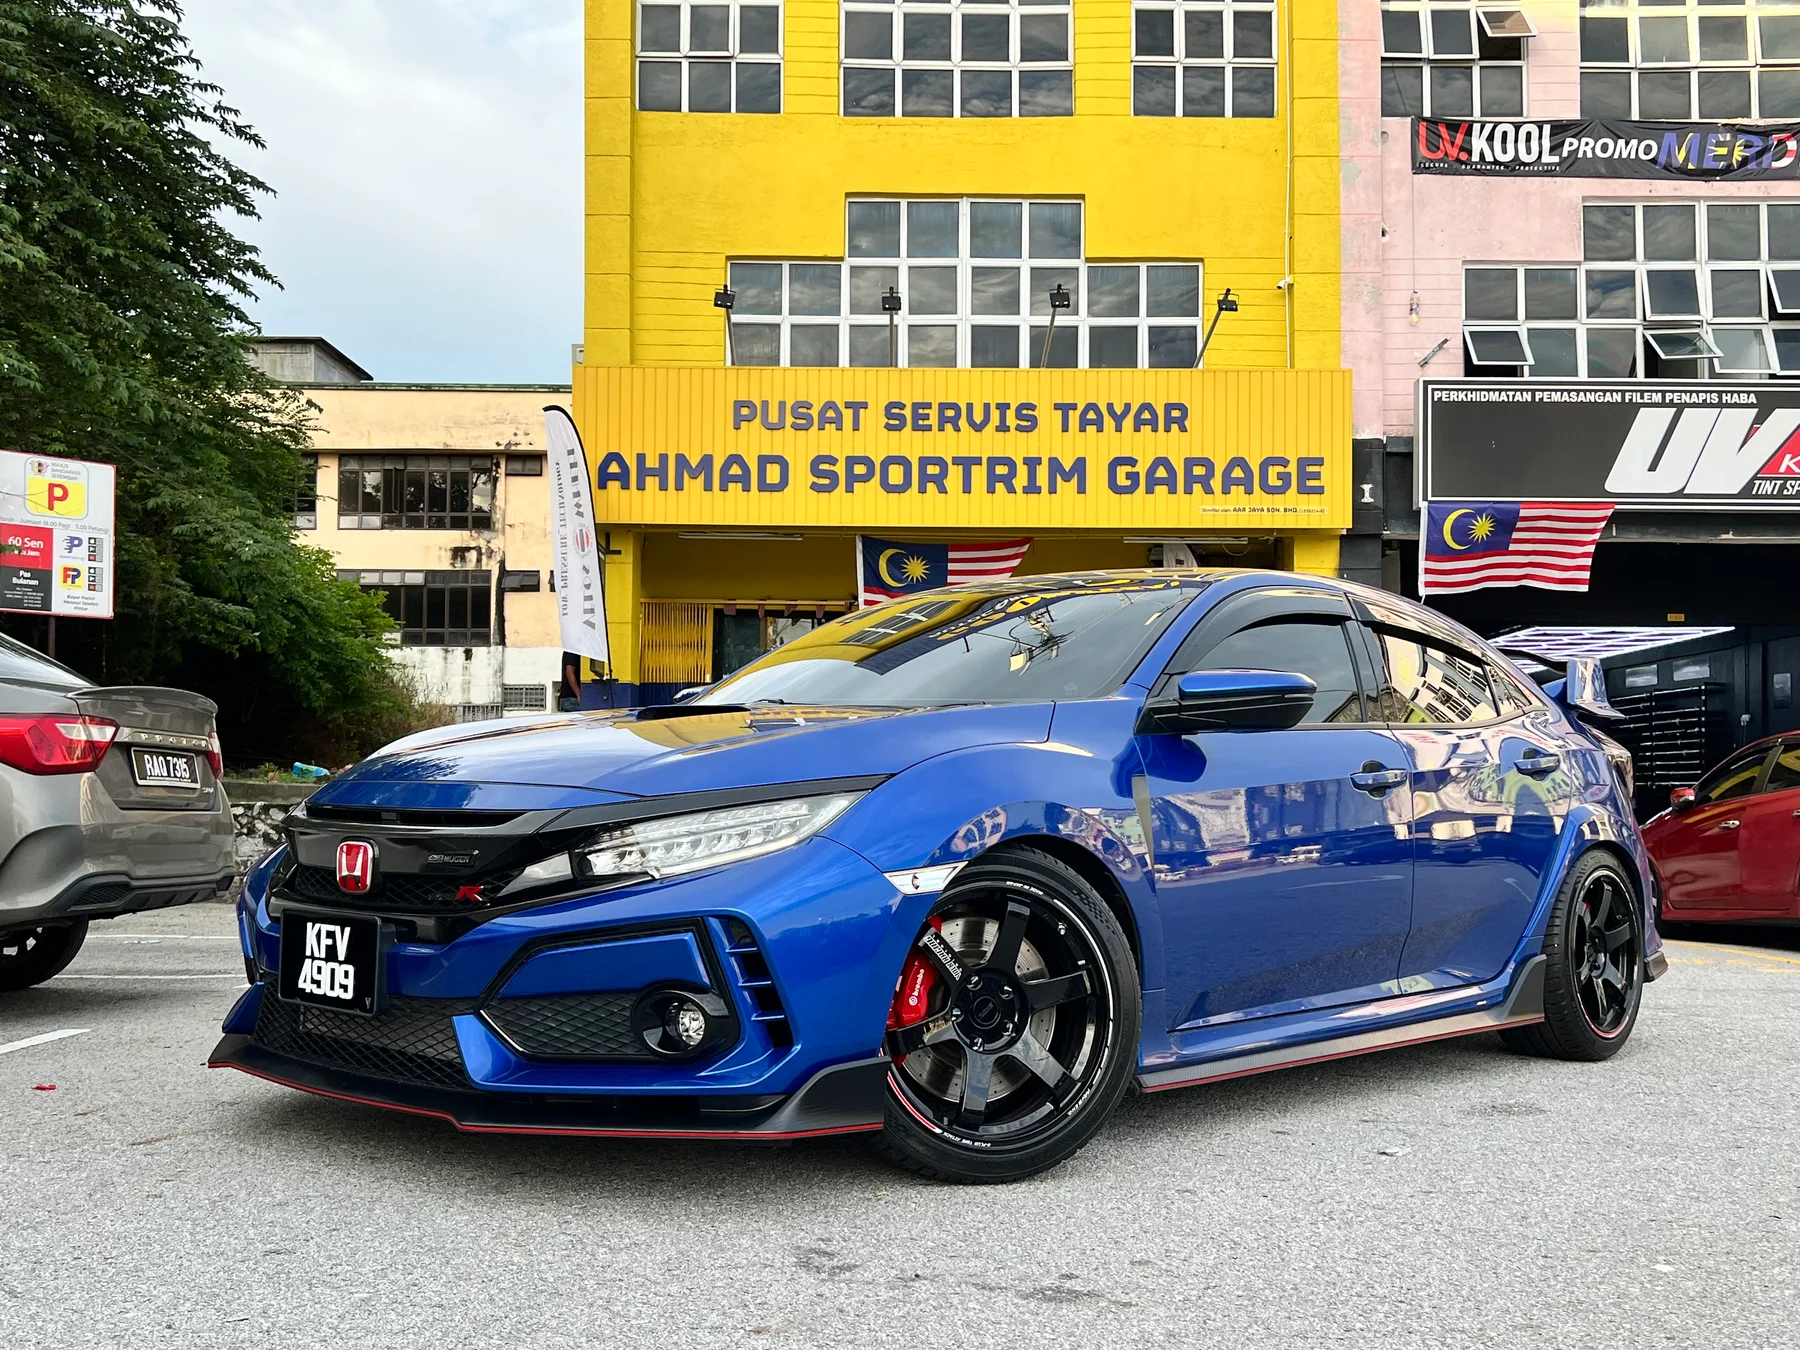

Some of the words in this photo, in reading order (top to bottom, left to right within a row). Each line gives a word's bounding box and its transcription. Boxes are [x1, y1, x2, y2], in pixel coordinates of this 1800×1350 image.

[1562, 137, 1658, 161] PROMO
[1461, 163, 1505, 171] GUARANTEE
[1433, 390, 1532, 403] PERKHIDMATAN
[1534, 391, 1623, 404] PEMASANGAN
[1625, 391, 1662, 404] FILEM
[1665, 392, 1719, 404] PENAPIS
[1722, 393, 1757, 404] HABA
[733, 399, 868, 430] PUSAT
[883, 401, 1039, 432] SERVIS
[1053, 402, 1189, 433] TAYAR
[597, 451, 789, 492] AHMAD
[809, 454, 1087, 494] SPORTRIM
[1107, 456, 1325, 495] GARAGE
[48, 483, 69, 511] P
[1751, 480, 1784, 495] TINT
[24, 537, 44, 549] Sen
[19, 570, 31, 578] Pas
[166, 756, 190, 779] 7315
[305, 921, 351, 962] KFV
[297, 958, 355, 1000] 4909
[911, 968, 925, 997] brembo
